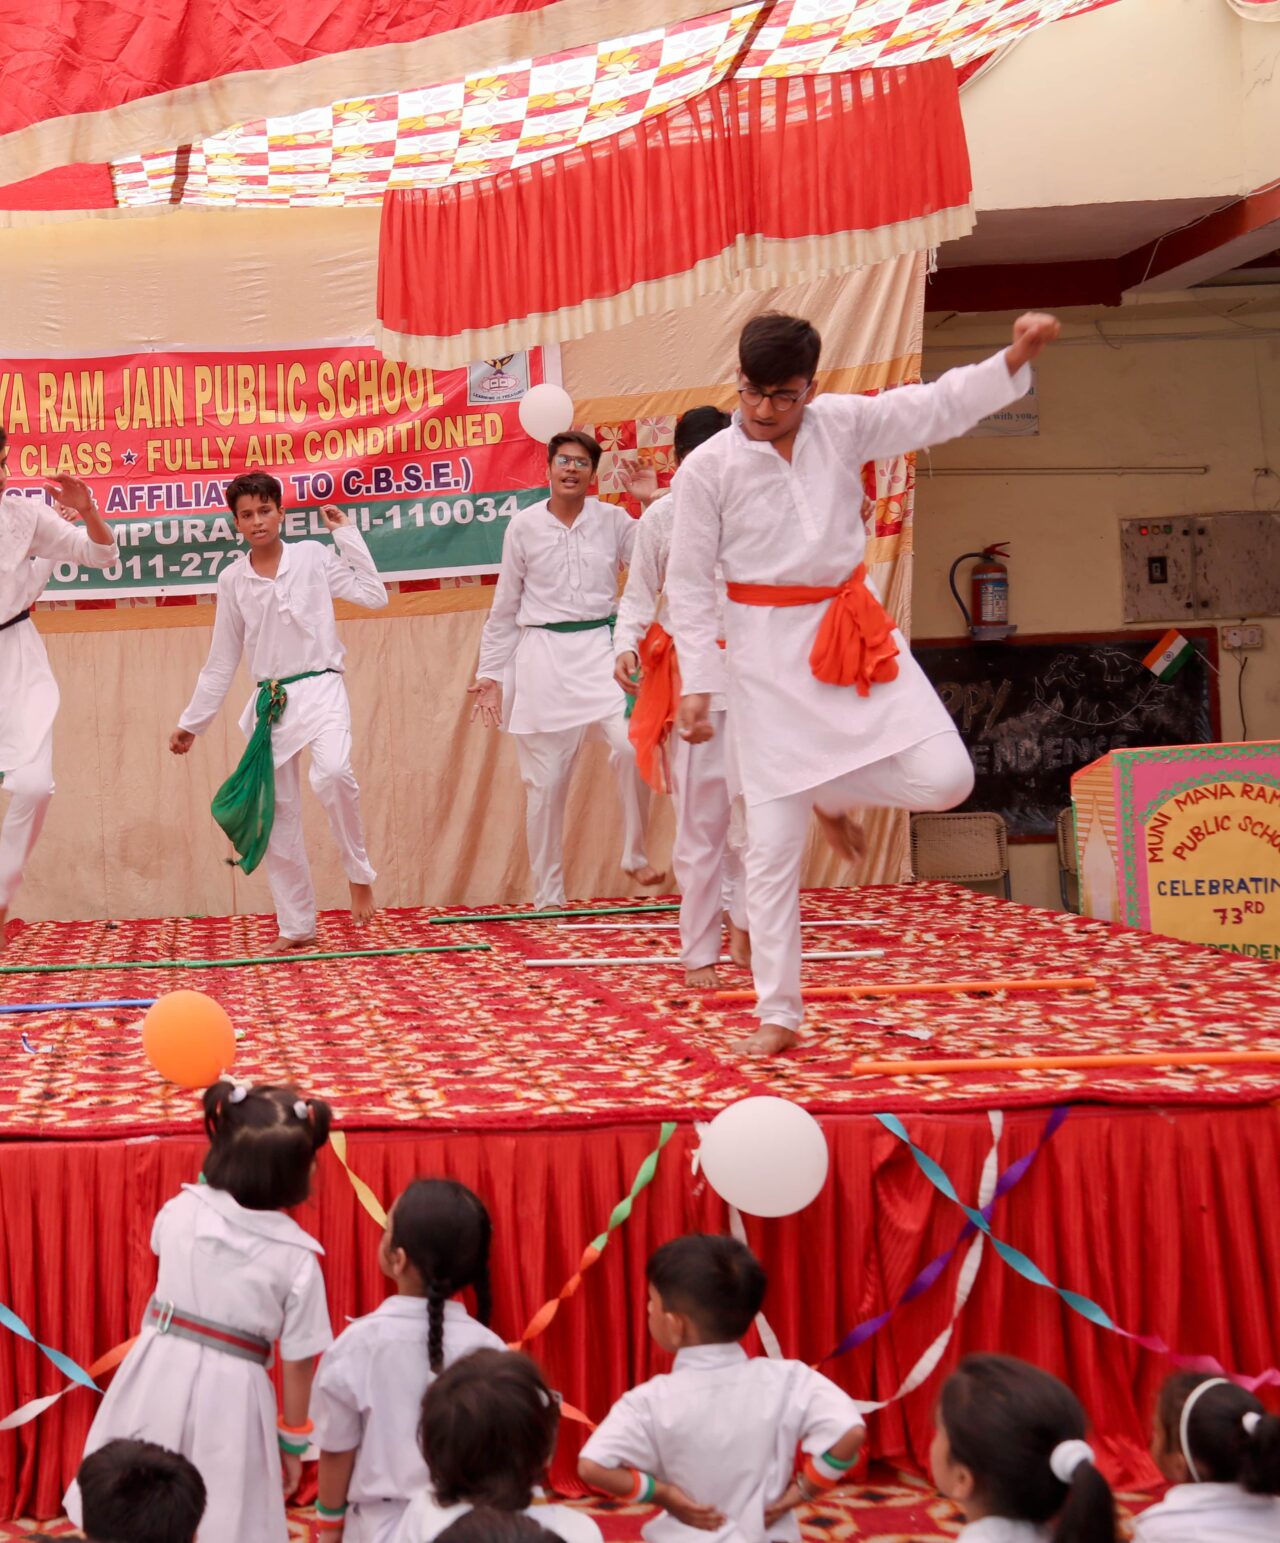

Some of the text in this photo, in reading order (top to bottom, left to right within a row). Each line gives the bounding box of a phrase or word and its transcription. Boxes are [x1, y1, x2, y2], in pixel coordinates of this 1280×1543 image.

[38, 370, 105, 433] RAM
[114, 366, 185, 430] JAIN
[194, 362, 308, 427] PUBLIC
[317, 359, 444, 421] SCHOOL
[20, 441, 113, 477] CLASS
[147, 435, 236, 472] FULLY
[244, 432, 296, 468] AIR
[303, 412, 504, 463] CONDITIONED
[106, 478, 284, 512] AFFILIA
[292, 472, 334, 501] TO
[342, 456, 473, 497] C.B.S.E.)
[52, 560, 89, 582] O.
[1148, 782, 1280, 864] MUNI MAYA RAM
[1172, 815, 1280, 861] PUBLIC SCHO
